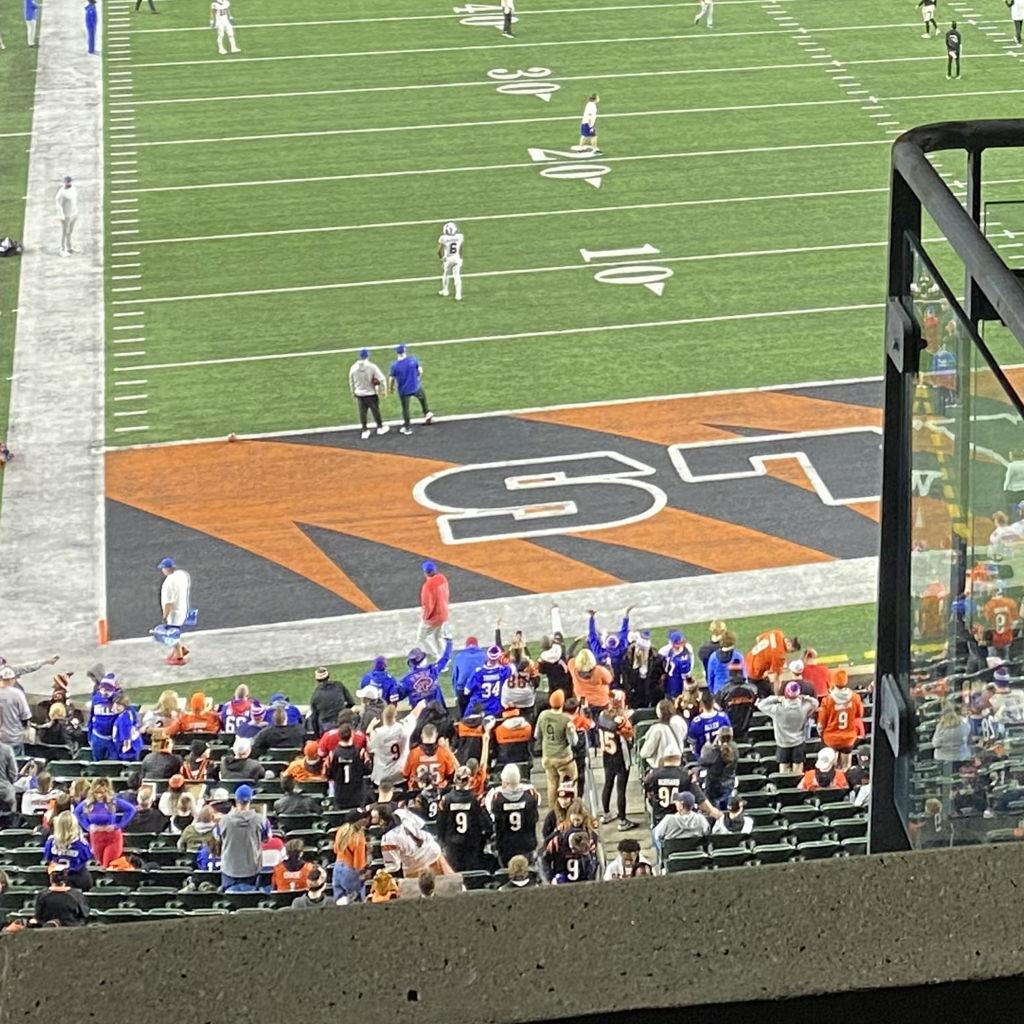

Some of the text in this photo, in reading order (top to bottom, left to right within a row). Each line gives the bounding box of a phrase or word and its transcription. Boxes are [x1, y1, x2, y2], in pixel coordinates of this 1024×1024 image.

[579, 243, 675, 285] 10
[481, 682, 500, 699] 34
[838, 711, 848, 730] 9
[390, 742, 401, 762] 9
[343, 764, 351, 784] 1
[455, 812, 468, 834] 9
[509, 812, 522, 832] 9
[567, 858, 579, 881] 9
